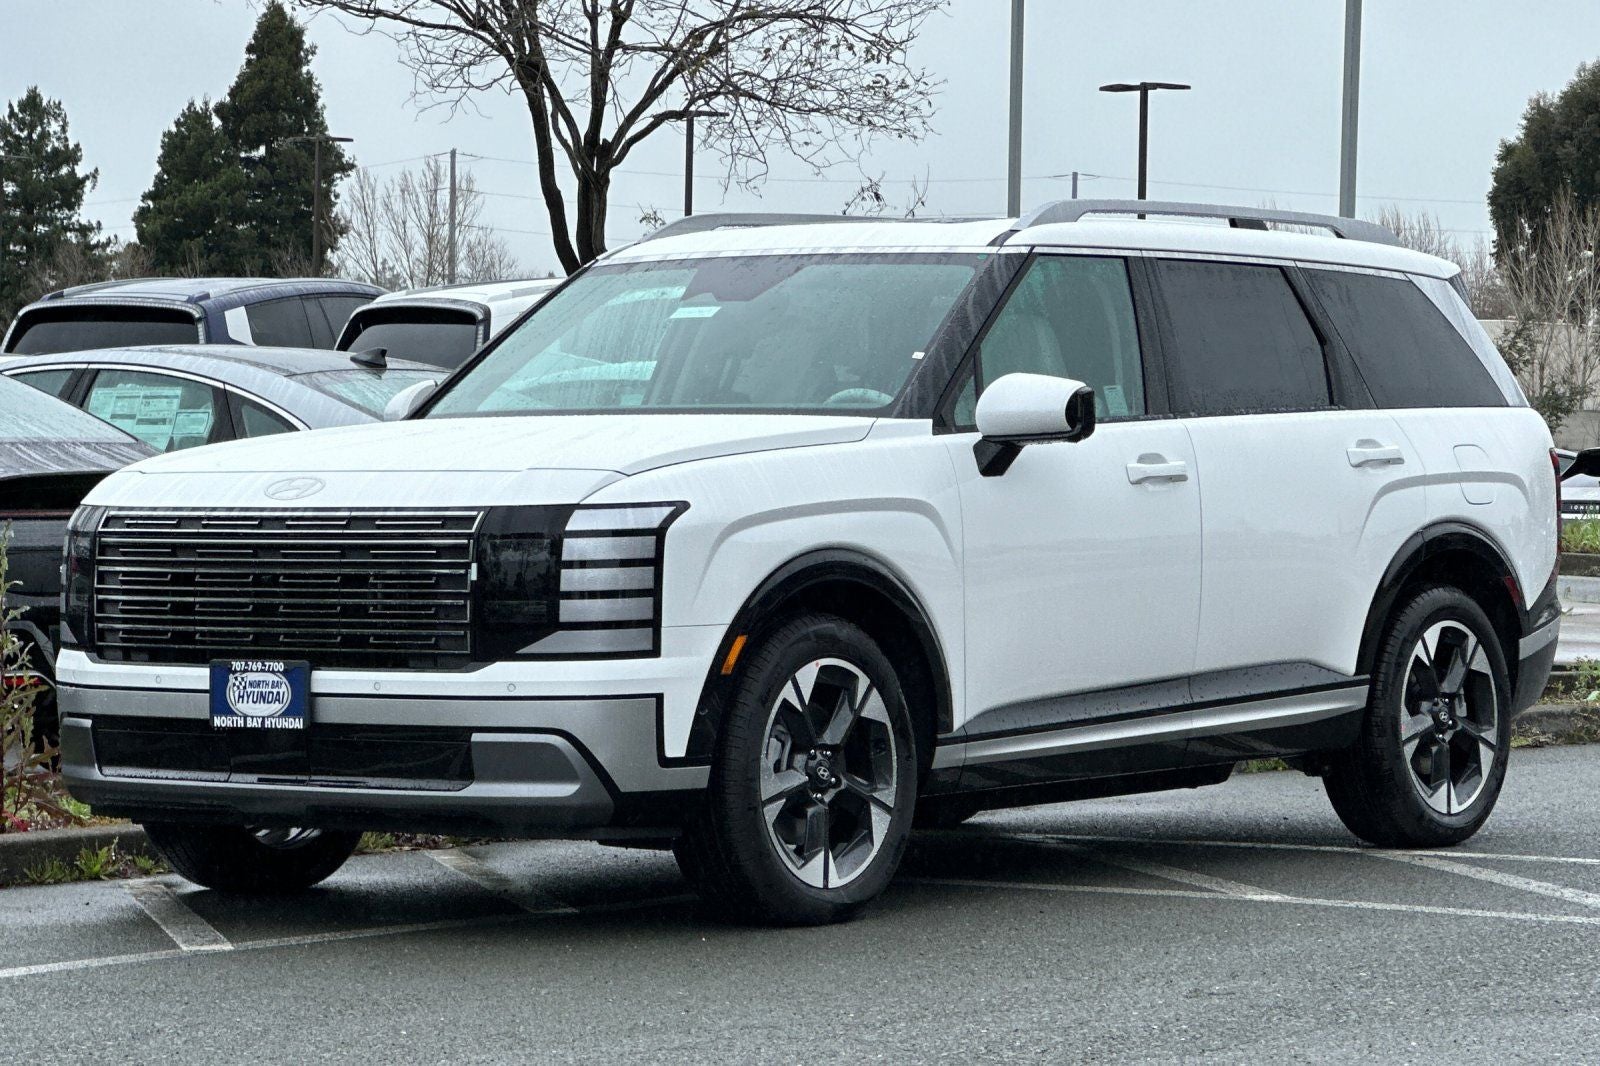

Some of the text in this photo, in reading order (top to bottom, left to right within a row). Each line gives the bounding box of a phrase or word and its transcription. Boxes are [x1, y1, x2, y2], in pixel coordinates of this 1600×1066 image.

[231, 661, 284, 671] 707-769-7700
[248, 680, 284, 689] NORTH BAY
[237, 690, 285, 704] HYUNDAI
[213, 716, 304, 729] NORTH BAY HYUNDAI
